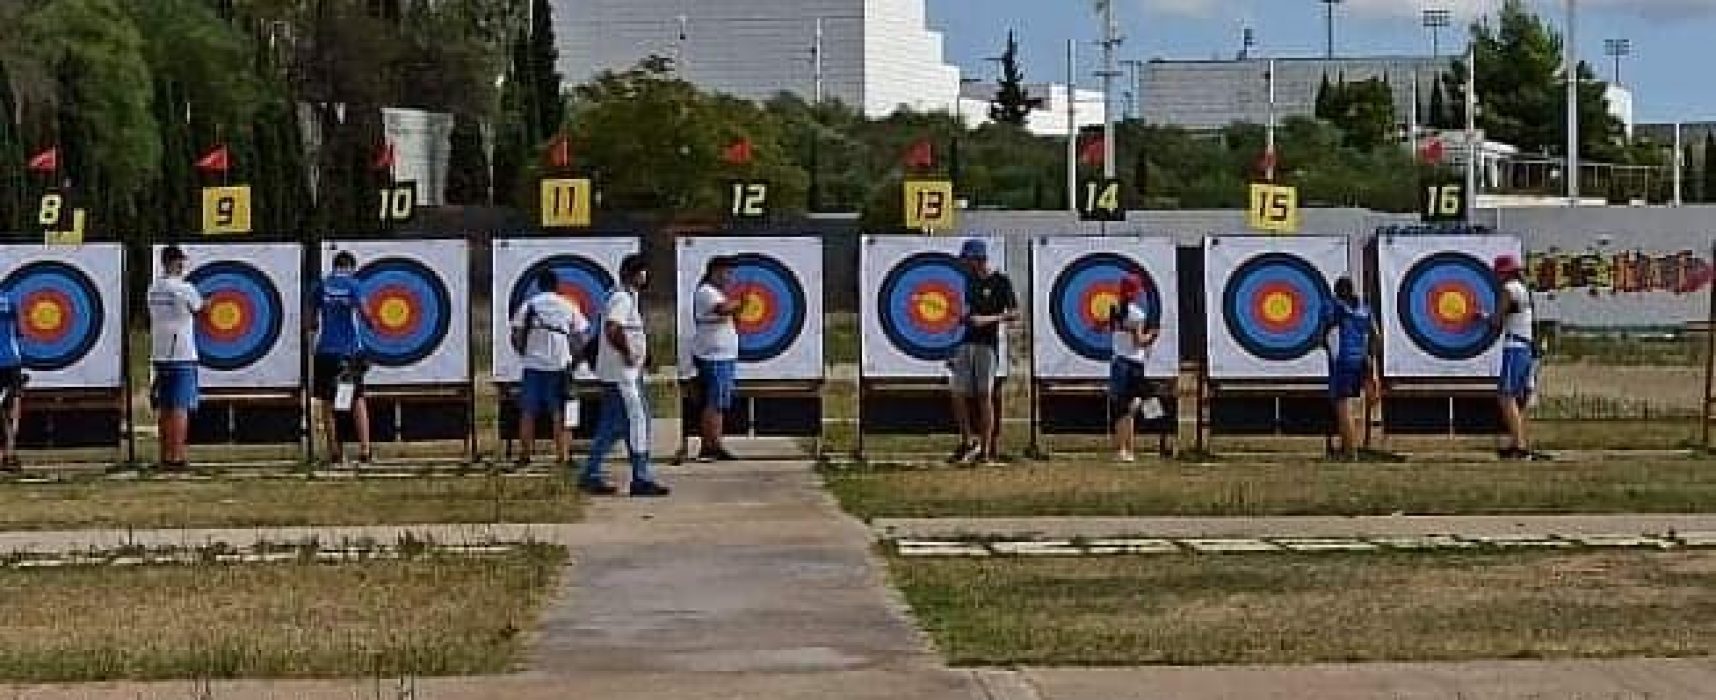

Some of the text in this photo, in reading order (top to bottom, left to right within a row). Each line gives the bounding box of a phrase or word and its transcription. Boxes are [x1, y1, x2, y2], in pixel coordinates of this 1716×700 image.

[40, 194, 61, 224] 8
[217, 198, 233, 224] 9
[380, 189, 412, 218] 10
[554, 186, 576, 215] 11
[732, 184, 765, 214] 12
[917, 191, 943, 219] 13
[1086, 182, 1119, 211] 14
[1260, 193, 1287, 219] 15
[1428, 186, 1460, 215] 16
